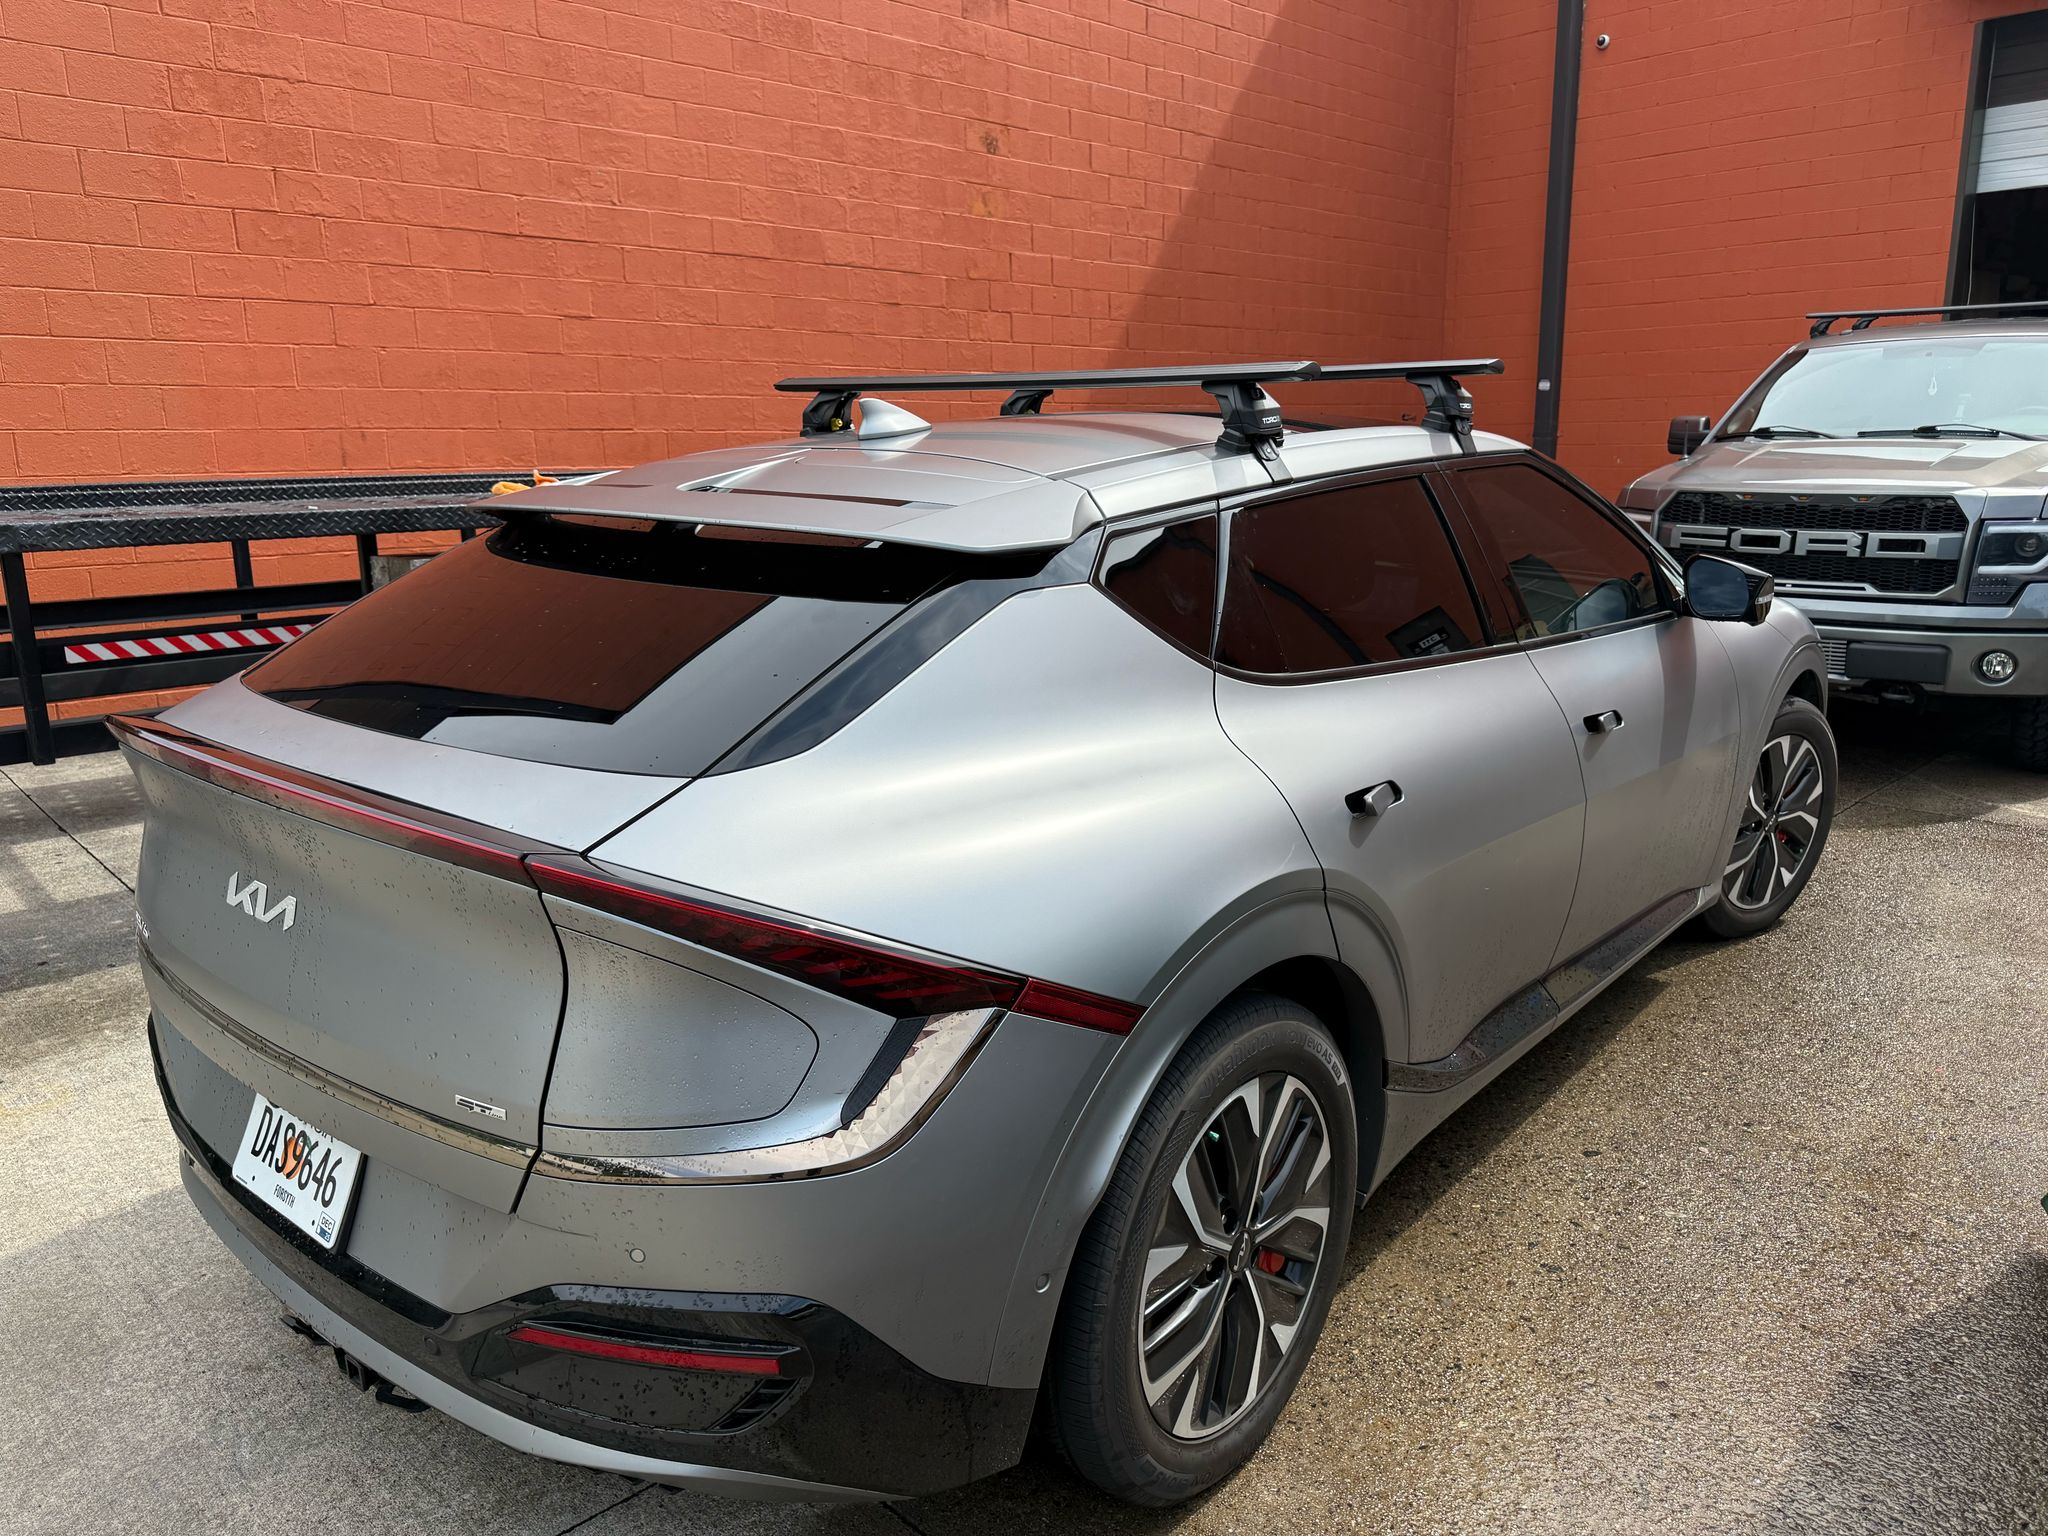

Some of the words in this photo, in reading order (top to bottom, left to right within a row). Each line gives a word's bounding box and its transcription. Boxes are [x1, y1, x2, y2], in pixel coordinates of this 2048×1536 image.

[1671, 524, 1938, 558] FORD
[226, 871, 297, 932] KIA
[250, 1104, 343, 1209] DAS9646
[273, 1183, 296, 1209] FORSYTH
[320, 1216, 333, 1231] DEC
